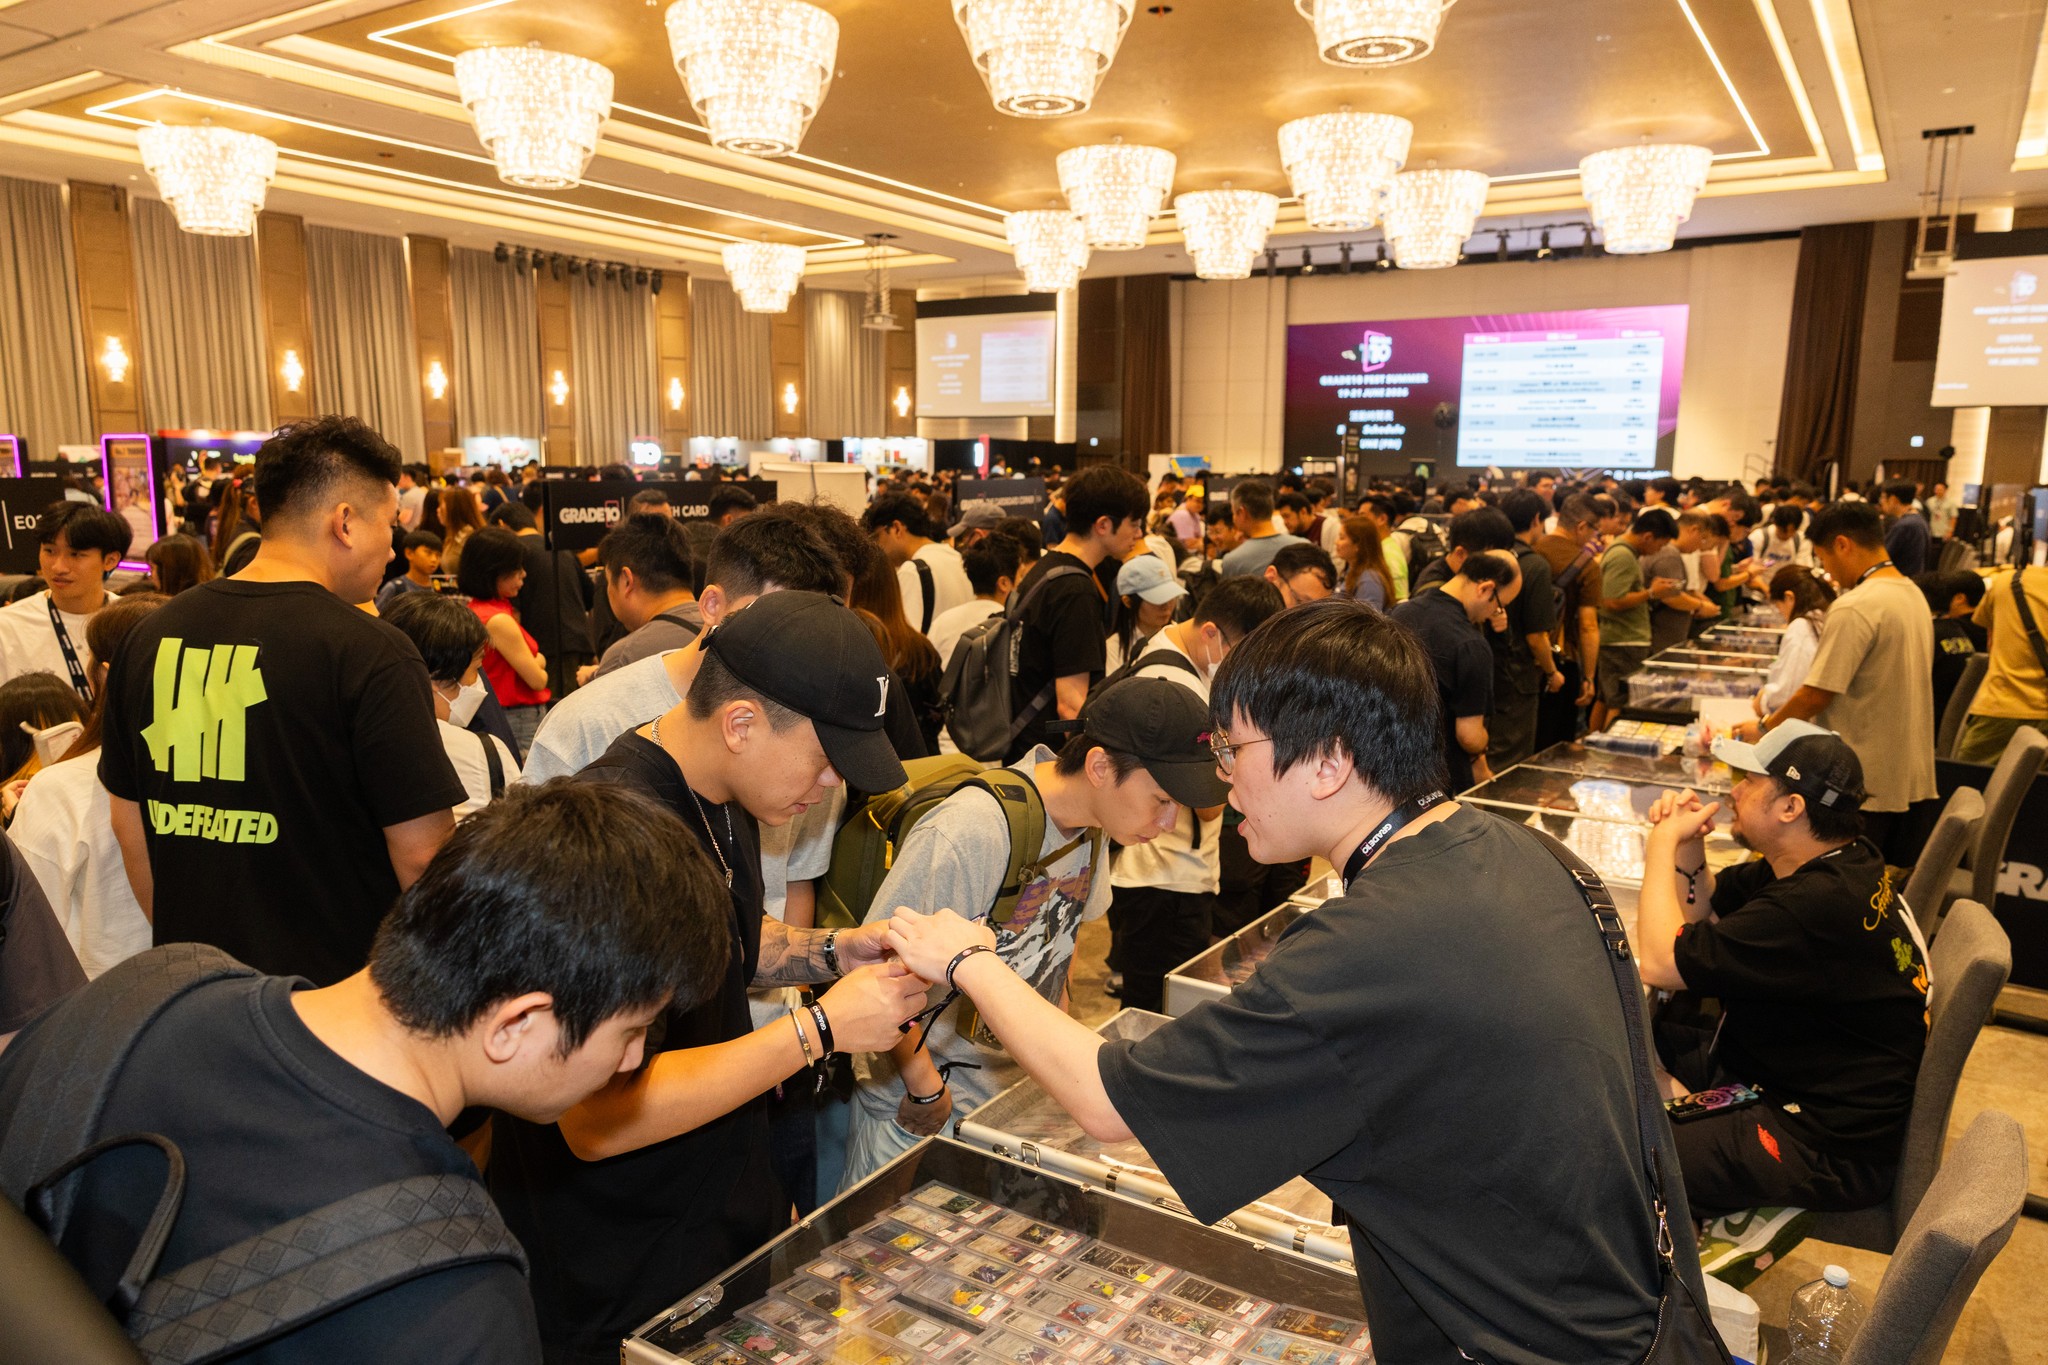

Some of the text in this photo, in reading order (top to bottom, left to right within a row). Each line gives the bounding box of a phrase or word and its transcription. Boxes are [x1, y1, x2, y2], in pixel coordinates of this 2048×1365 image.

[1319, 373, 1429, 386] GRADE10 FEST SUMMER
[631, 442, 662, 466] 10
[559, 507, 621, 524] GRADE10
[682, 504, 709, 518] CARD
[14, 514, 43, 530] E0
[1361, 823, 1392, 854] GRADE10
